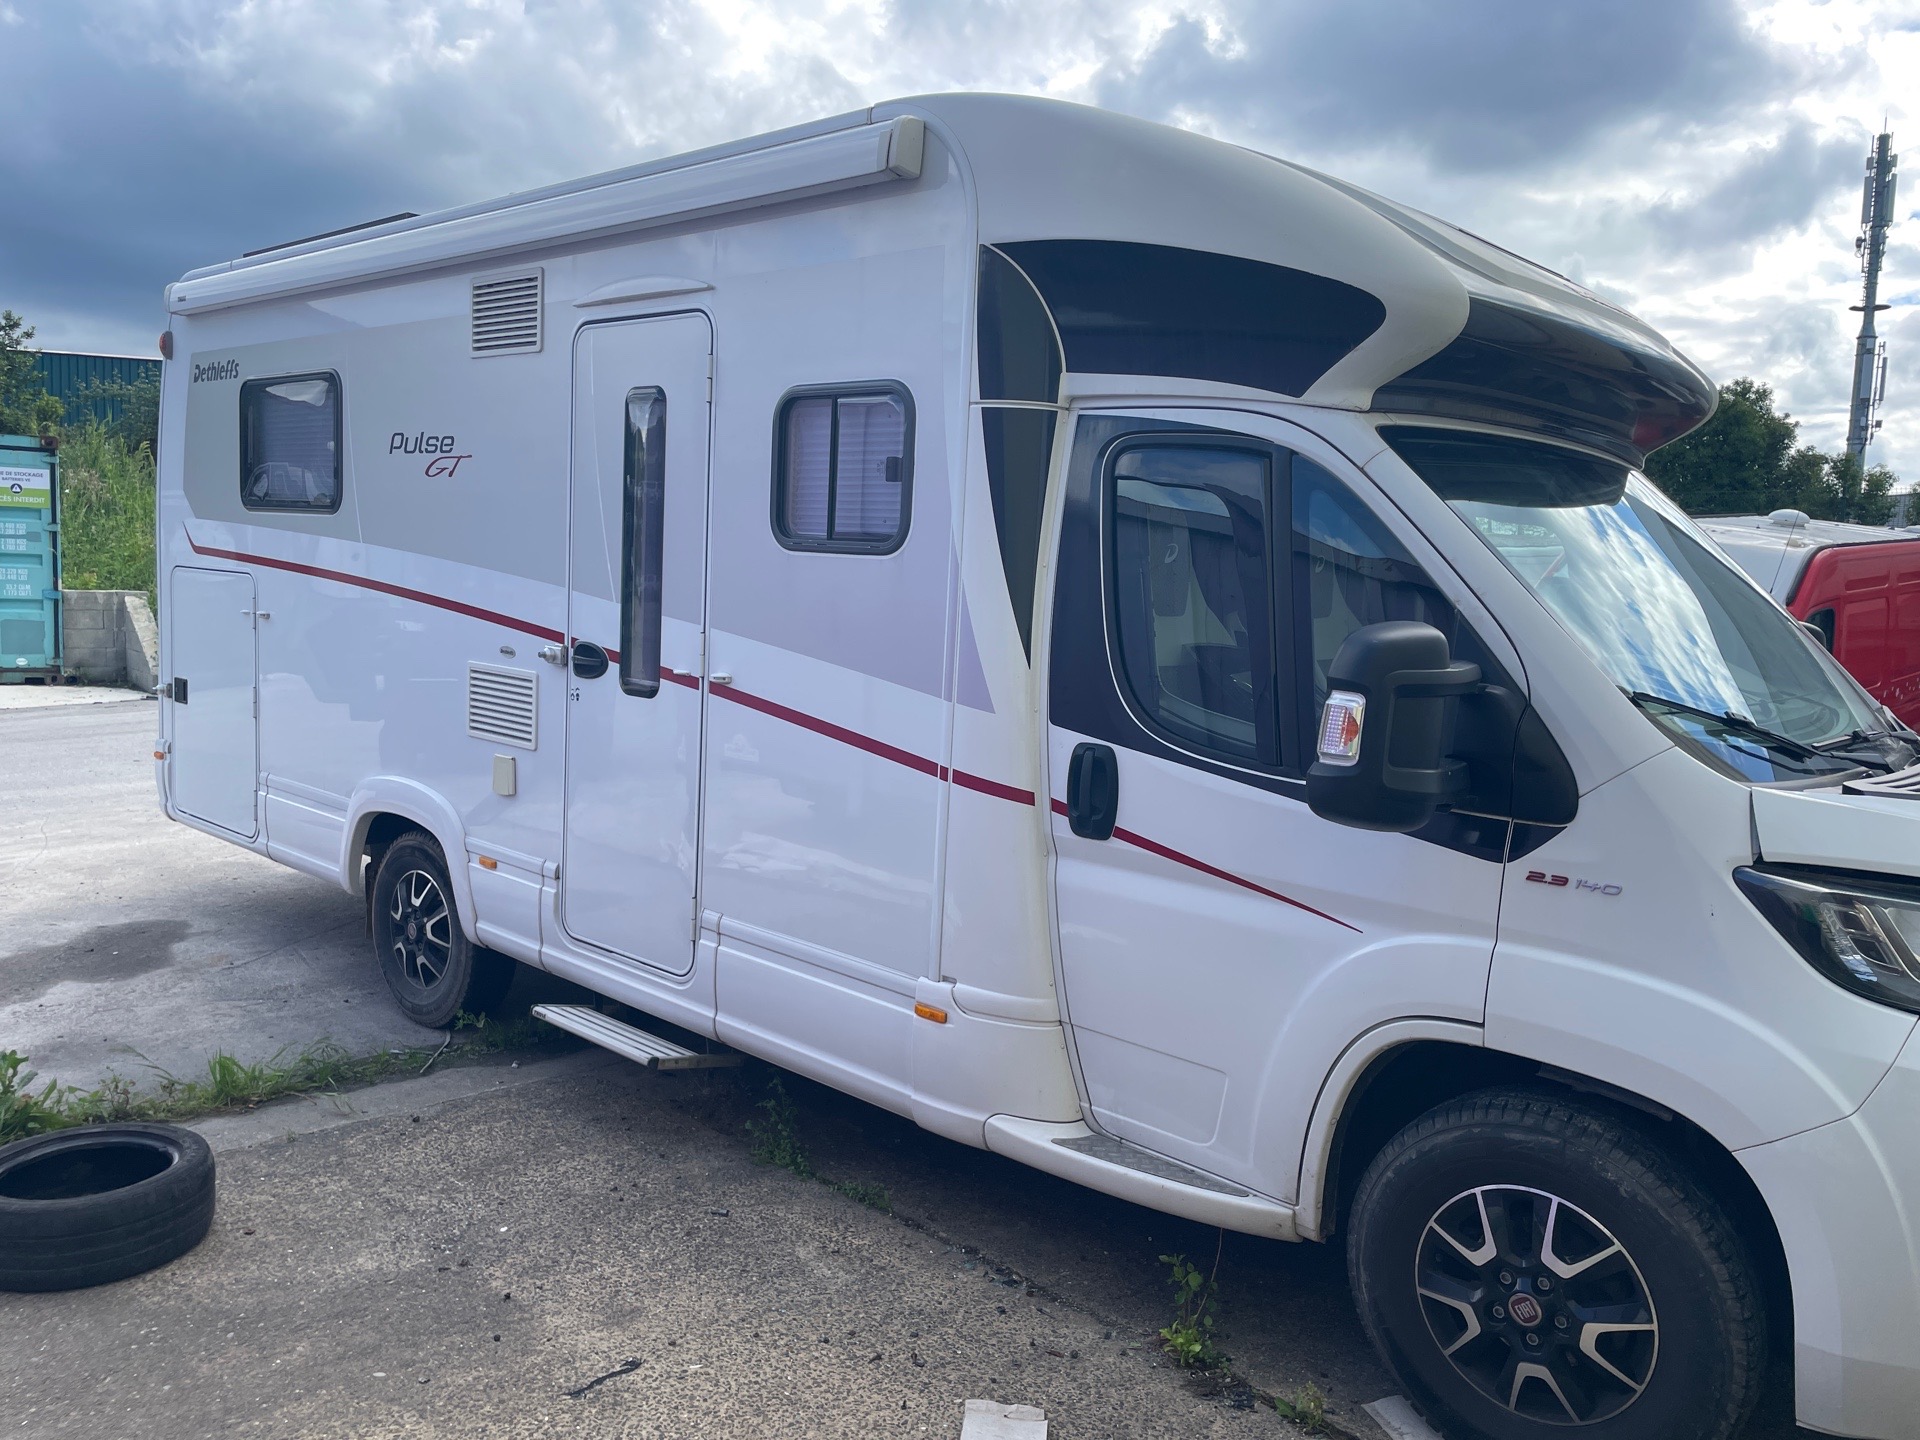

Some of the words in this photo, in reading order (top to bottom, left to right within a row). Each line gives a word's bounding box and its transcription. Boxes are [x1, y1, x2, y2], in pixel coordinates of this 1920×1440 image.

[193, 358, 240, 384] Dethleffs
[424, 454, 472, 478] GT
[13, 496, 45, 504] INTERDIT
[1525, 870, 1569, 887] 2.3
[1574, 878, 1623, 896] 140
[1514, 1300, 1536, 1320] FIAT
